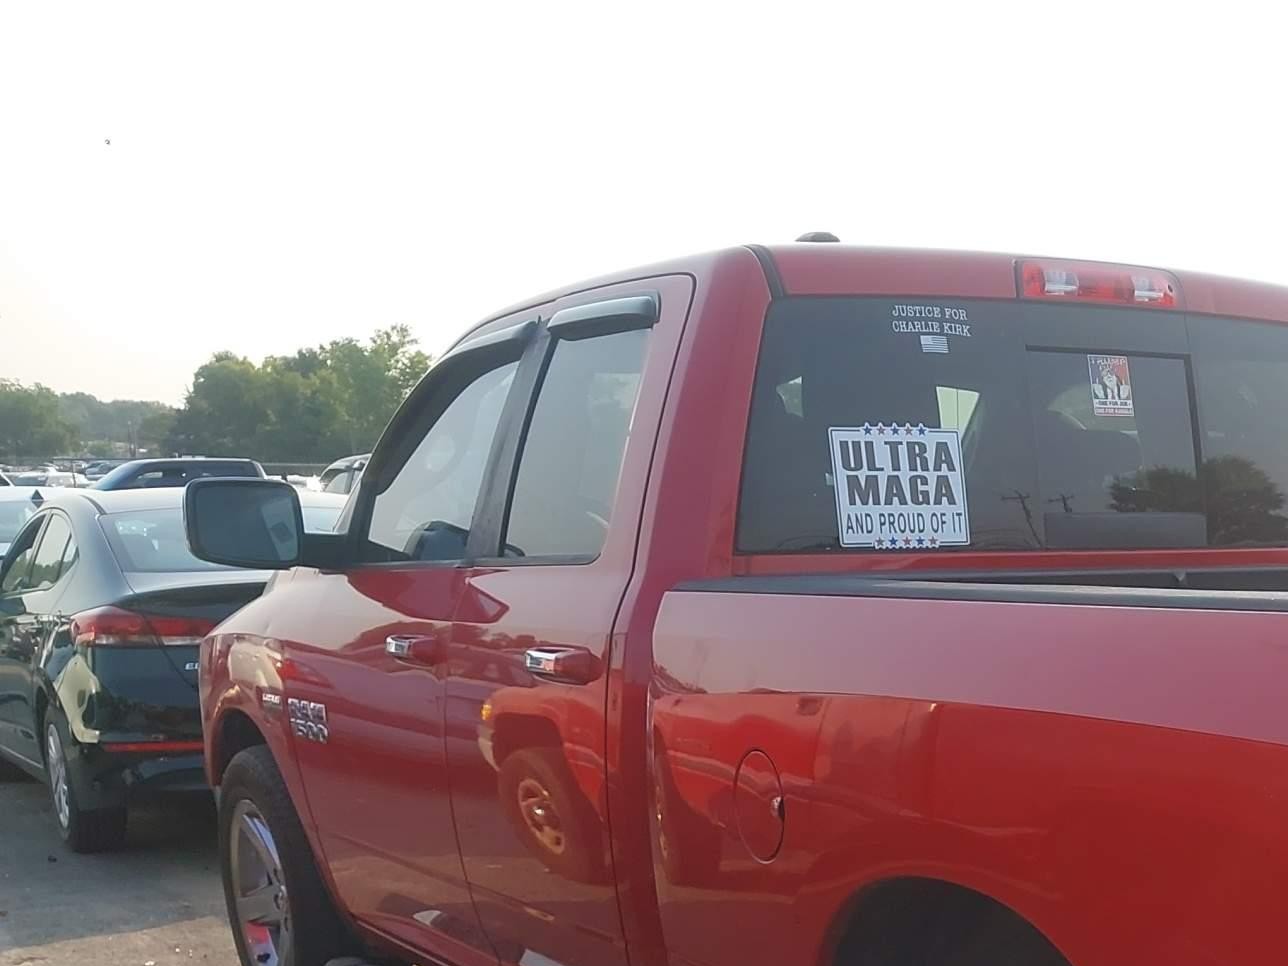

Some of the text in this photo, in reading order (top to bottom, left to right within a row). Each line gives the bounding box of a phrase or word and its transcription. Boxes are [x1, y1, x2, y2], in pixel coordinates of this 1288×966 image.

[892, 305, 967, 320] JUSTICE FOR
[892, 321, 971, 336] CHARLIE KIRK
[839, 440, 956, 472] ULTRA
[846, 474, 957, 506] MAGA
[846, 512, 962, 535] AND PROUD OF IT
[287, 697, 327, 721] RAM
[289, 718, 329, 745] 1500
